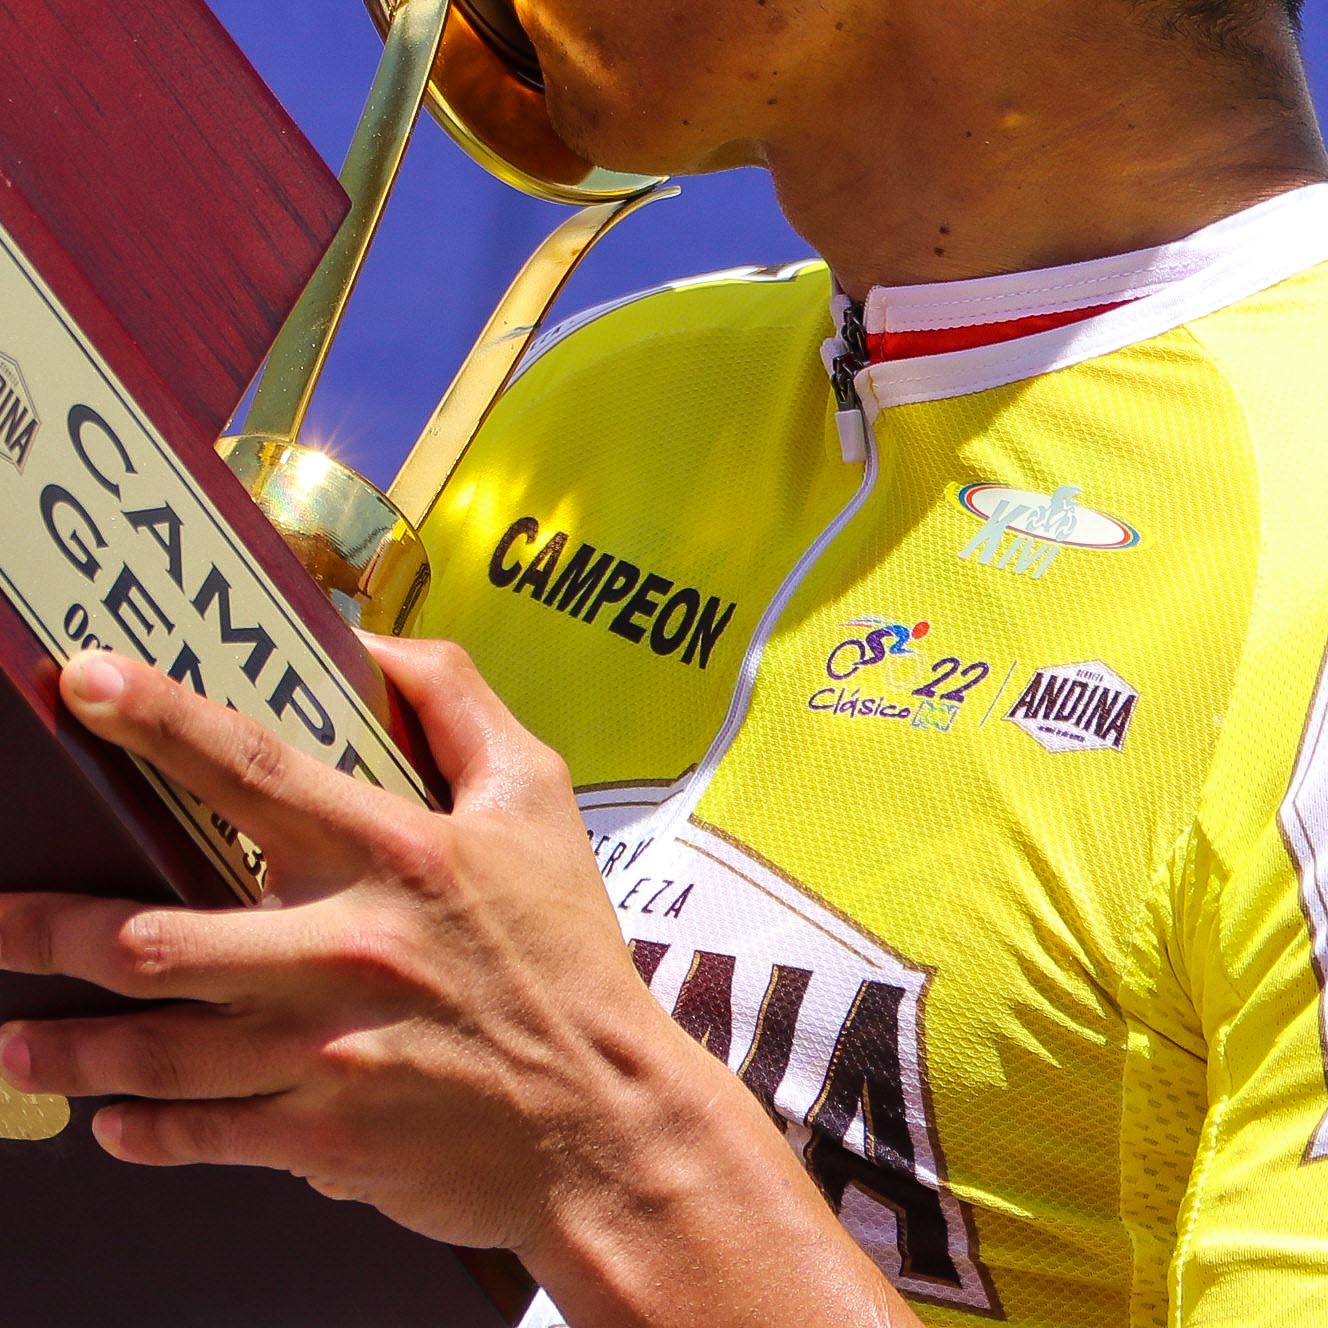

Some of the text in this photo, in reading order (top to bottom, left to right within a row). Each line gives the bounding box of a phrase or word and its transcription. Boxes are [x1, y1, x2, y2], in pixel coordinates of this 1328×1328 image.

[489, 516, 735, 670] CAMPEON
[808, 687, 913, 720] Clásico
[911, 657, 989, 702] 22
[1008, 671, 1136, 748] ANDINA
